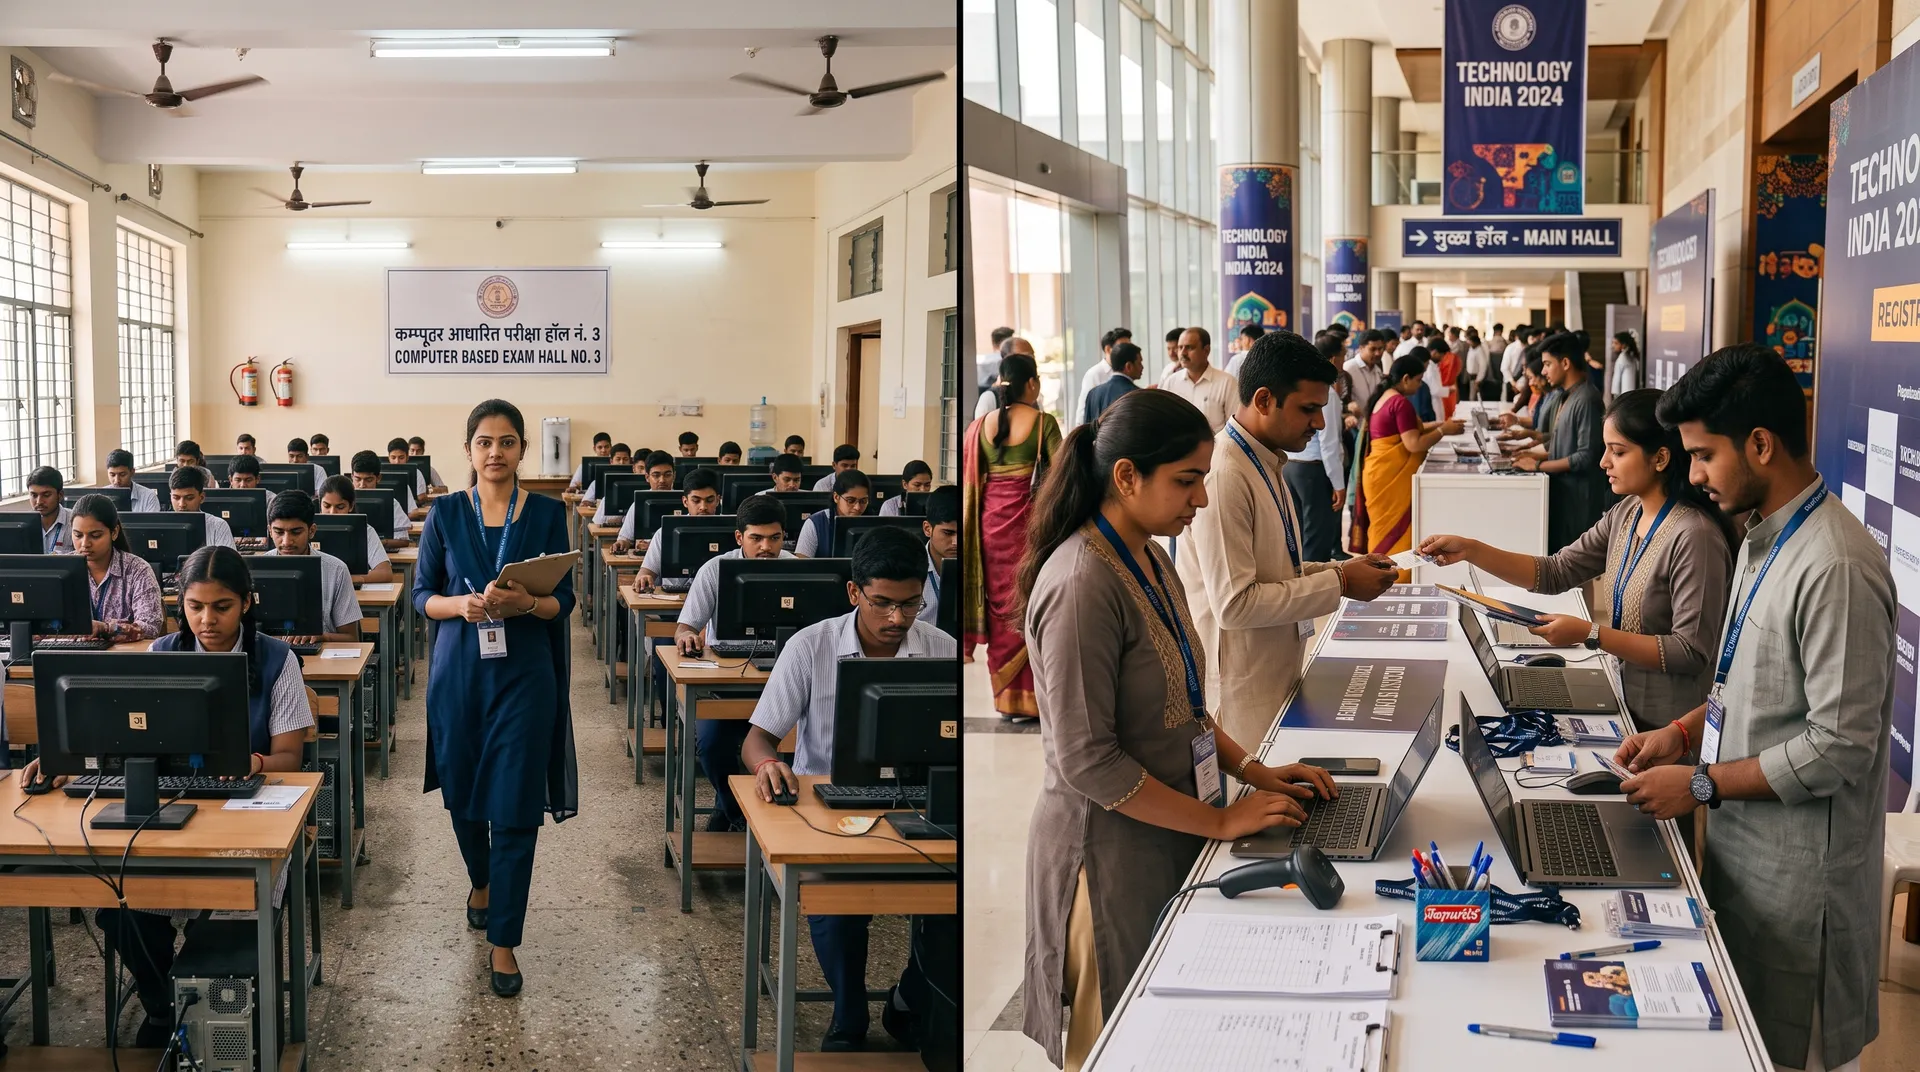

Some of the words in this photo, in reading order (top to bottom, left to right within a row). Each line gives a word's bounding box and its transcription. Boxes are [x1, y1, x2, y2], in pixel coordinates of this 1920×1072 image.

[1456, 61, 1573, 82] TECHNOLOGY
[1464, 86, 1513, 107] INDIA
[1517, 86, 1564, 107] 2024
[1850, 133, 1920, 204] TECHNO
[1221, 228, 1288, 243] TECHNOLOGY
[1847, 207, 1891, 258] INDIA
[1894, 197, 1920, 248] 20
[1523, 229, 1567, 246] MAIN
[1571, 229, 1615, 246] HALL
[1237, 244, 1268, 259] INDIA
[1224, 261, 1253, 276] INDIA
[1254, 260, 1284, 276] 2024
[448, 322, 501, 341] आधारित
[503, 322, 541, 343] परीक्षा
[544, 322, 571, 343] हॉल
[573, 323, 587, 341] नं.
[592, 327, 601, 341] 3
[395, 349, 458, 364] COMPUTER
[461, 349, 499, 364] BASED
[503, 349, 535, 364] EXAM
[538, 349, 568, 364] HALL
[571, 349, 591, 364] NO.
[594, 349, 601, 364] 3
